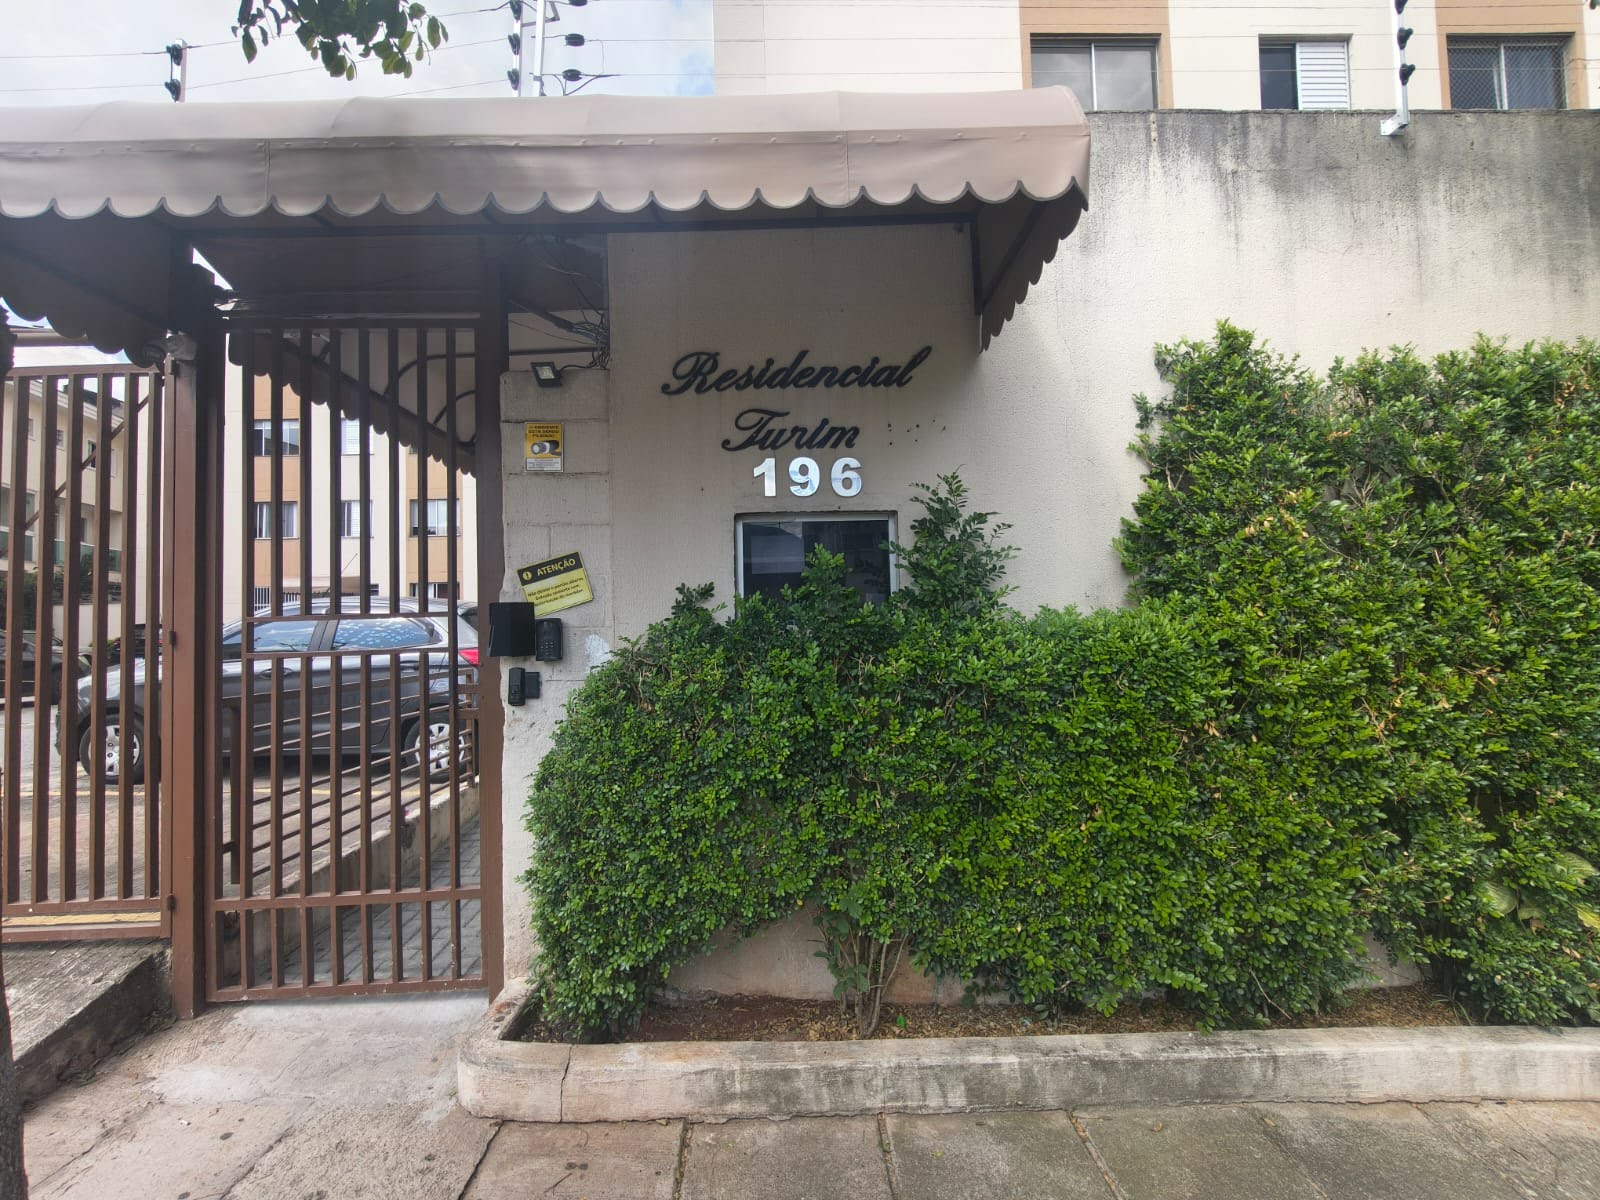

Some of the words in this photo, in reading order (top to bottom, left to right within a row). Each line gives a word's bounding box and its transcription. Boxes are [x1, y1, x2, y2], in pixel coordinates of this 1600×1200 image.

[661, 345, 932, 396] Residencial
[721, 408, 860, 452] Turim
[752, 456, 863, 498] 196
[537, 558, 576, 577] ATENÇÃO
